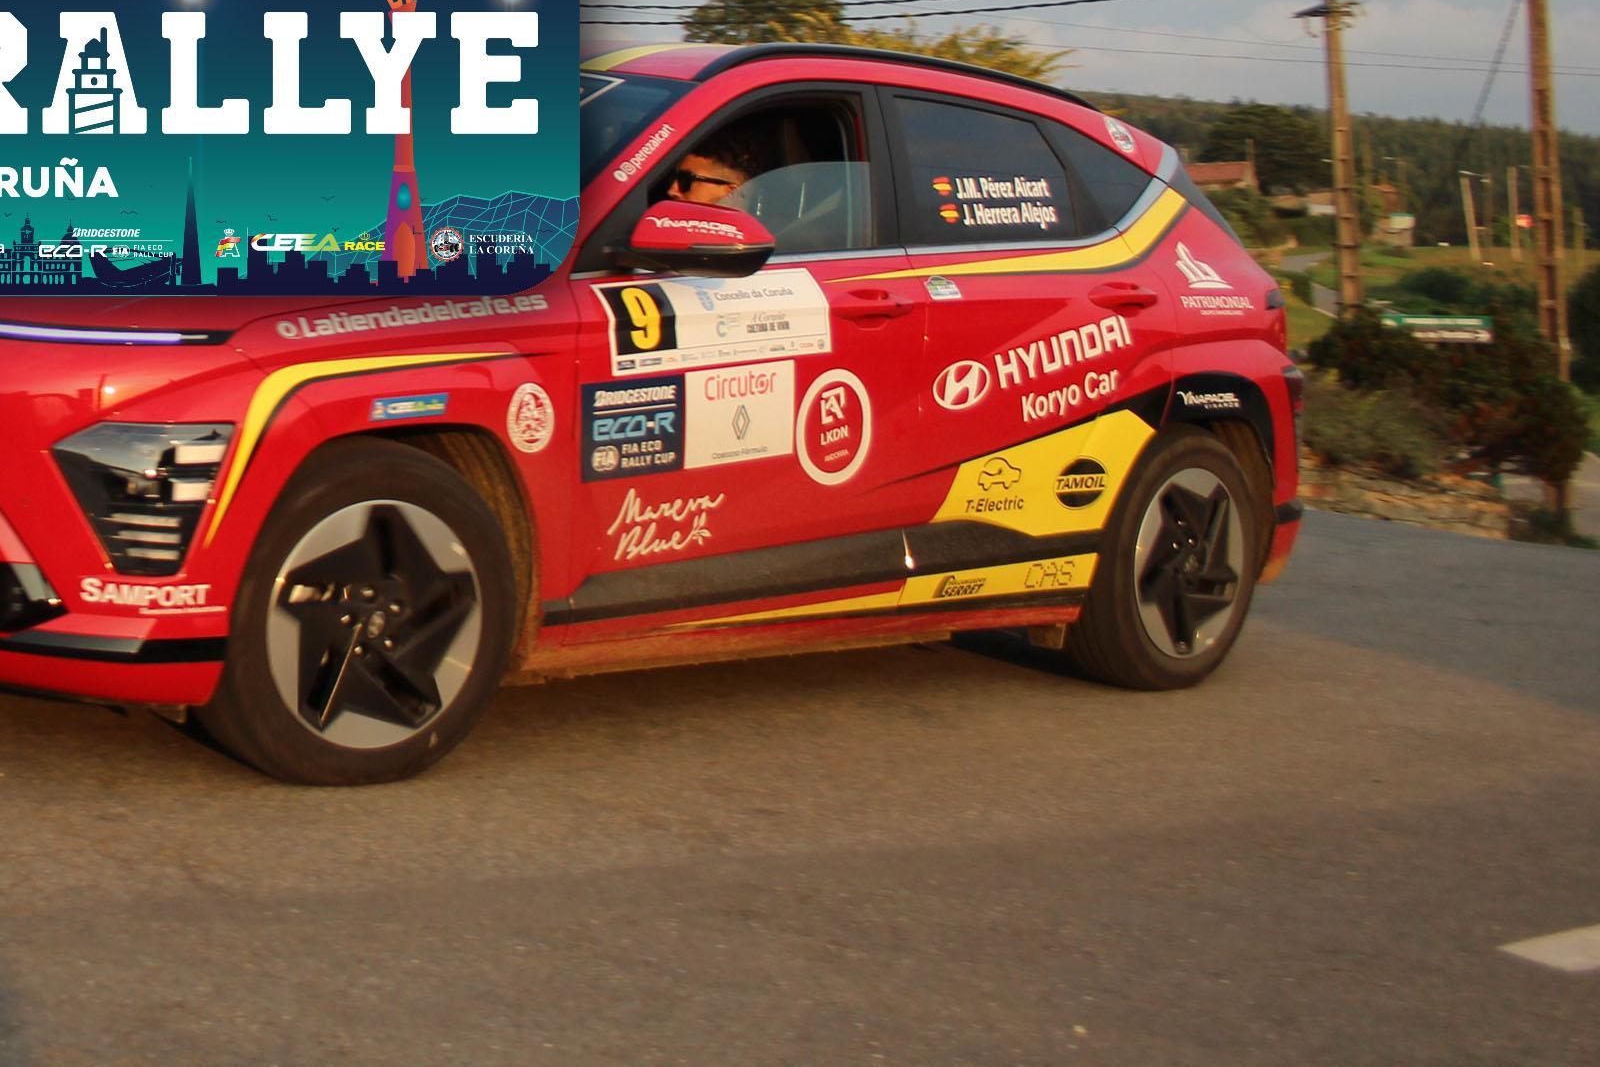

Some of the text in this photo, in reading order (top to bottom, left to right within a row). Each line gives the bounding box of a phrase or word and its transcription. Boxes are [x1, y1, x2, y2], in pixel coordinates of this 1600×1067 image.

[955, 176, 1051, 199] J.M. Pérez Aicart
[962, 201, 1058, 230] J. Herrera Alejos
[1180, 295, 1254, 309] PATRIMONIAL
[621, 287, 661, 350] 9
[994, 314, 1132, 389] HYUNDAI
[593, 384, 677, 407] BRIDGESTONE
[1020, 368, 1119, 422] Koryo Car
[820, 424, 849, 446] LKDN
[621, 440, 663, 455] FIA ECO
[621, 451, 677, 469] RALLY CUP
[1055, 476, 1106, 491] TAMOIL
[964, 495, 1025, 513] T-Electric
[1024, 560, 1076, 589] CAS
[79, 577, 212, 607] SAMPORT
